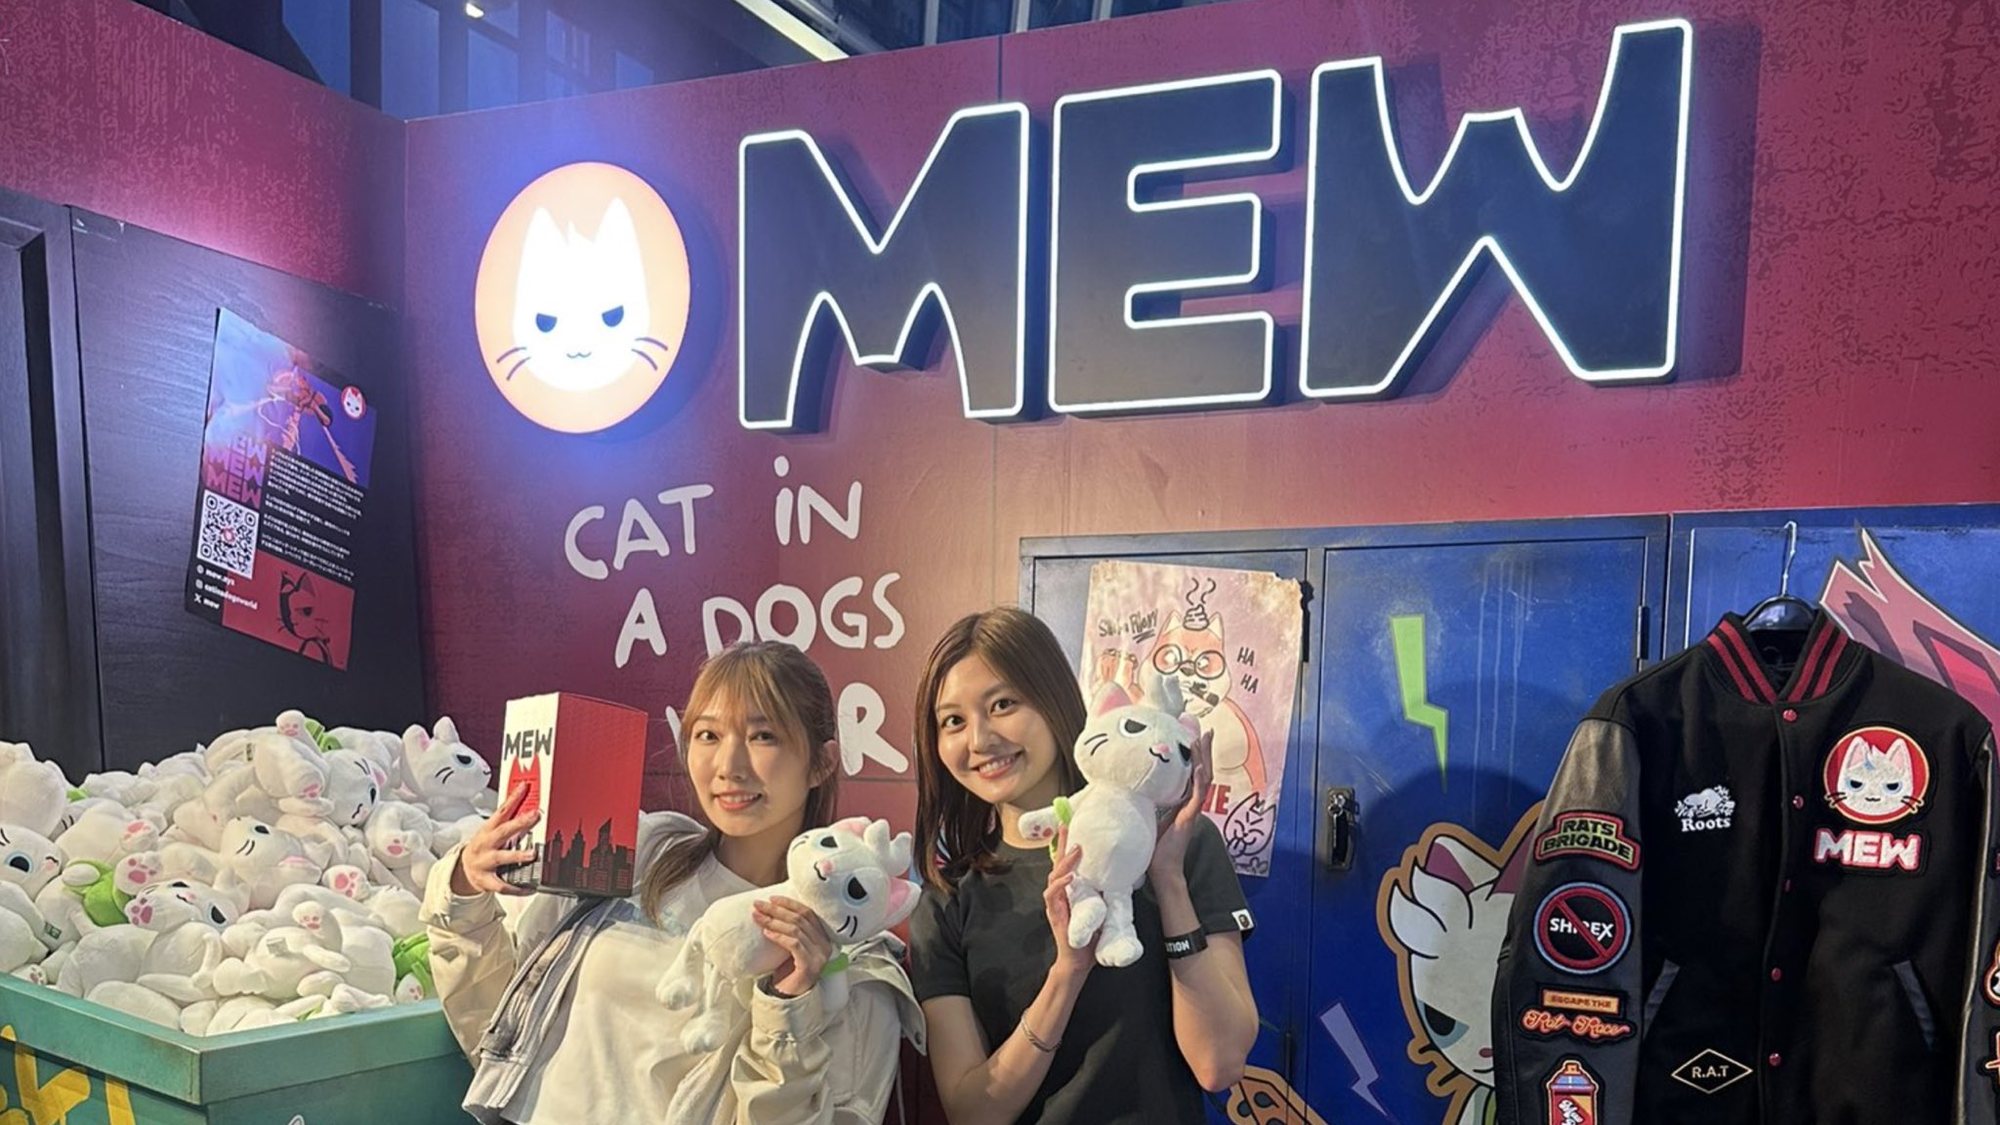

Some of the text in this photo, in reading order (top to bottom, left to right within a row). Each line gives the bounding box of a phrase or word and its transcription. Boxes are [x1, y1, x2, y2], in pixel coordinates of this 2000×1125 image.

[740, 18, 1693, 430] MEW
[207, 462, 262, 510] MEW
[565, 484, 714, 580] CAT
[615, 572, 906, 669] A DOGS
[1237, 647, 1255, 667] HA
[1240, 674, 1259, 694] HA
[504, 727, 553, 761] MEW
[1563, 820, 1616, 836] RATS
[1681, 817, 1732, 833] Roots
[1543, 835, 1633, 861] BRIGADE
[1814, 828, 1922, 872] MEW
[1551, 995, 1611, 1009] ESCAPE THE
[1523, 1009, 1631, 1039] Rat Race
[1692, 1065, 1730, 1079] R.A.T
